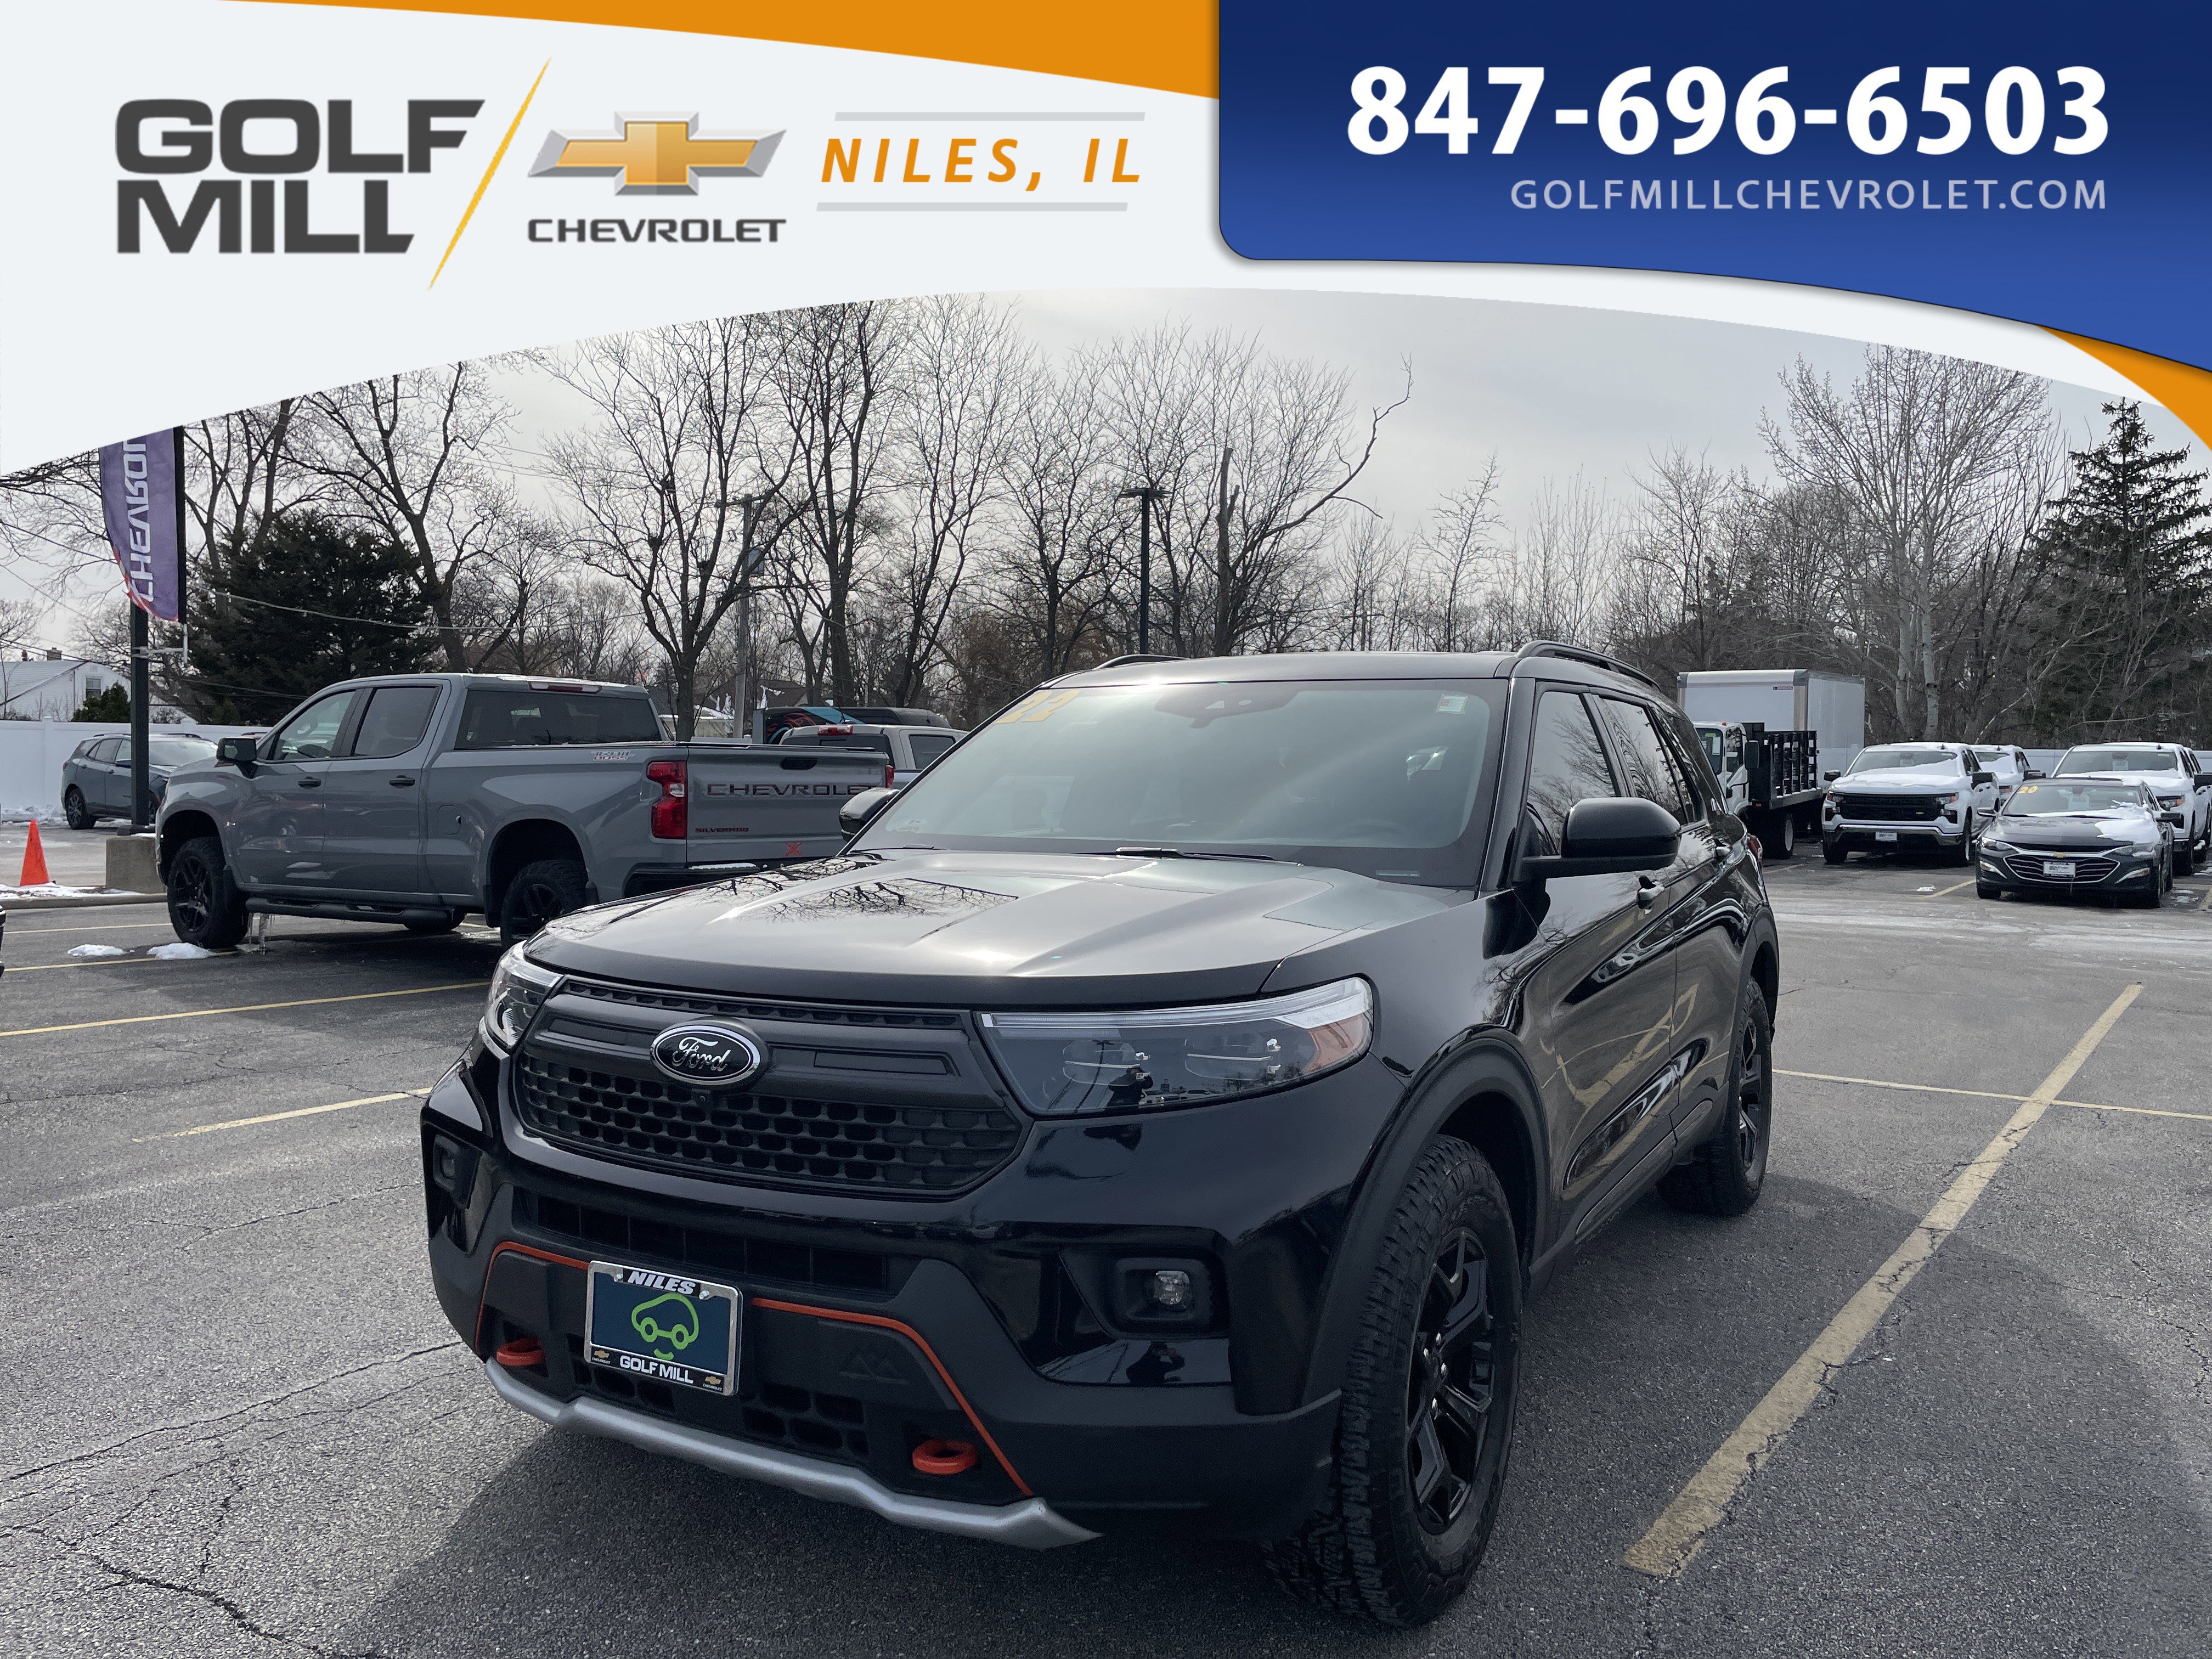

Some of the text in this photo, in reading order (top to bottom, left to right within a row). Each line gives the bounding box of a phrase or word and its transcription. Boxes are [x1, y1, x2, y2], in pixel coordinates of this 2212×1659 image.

[994, 689, 1080, 725] 22
[2018, 786, 2039, 794] 20
[671, 1036, 731, 1072] Ford
[627, 1271, 696, 1295] NILES
[619, 1355, 693, 1384] GOLF MILL
